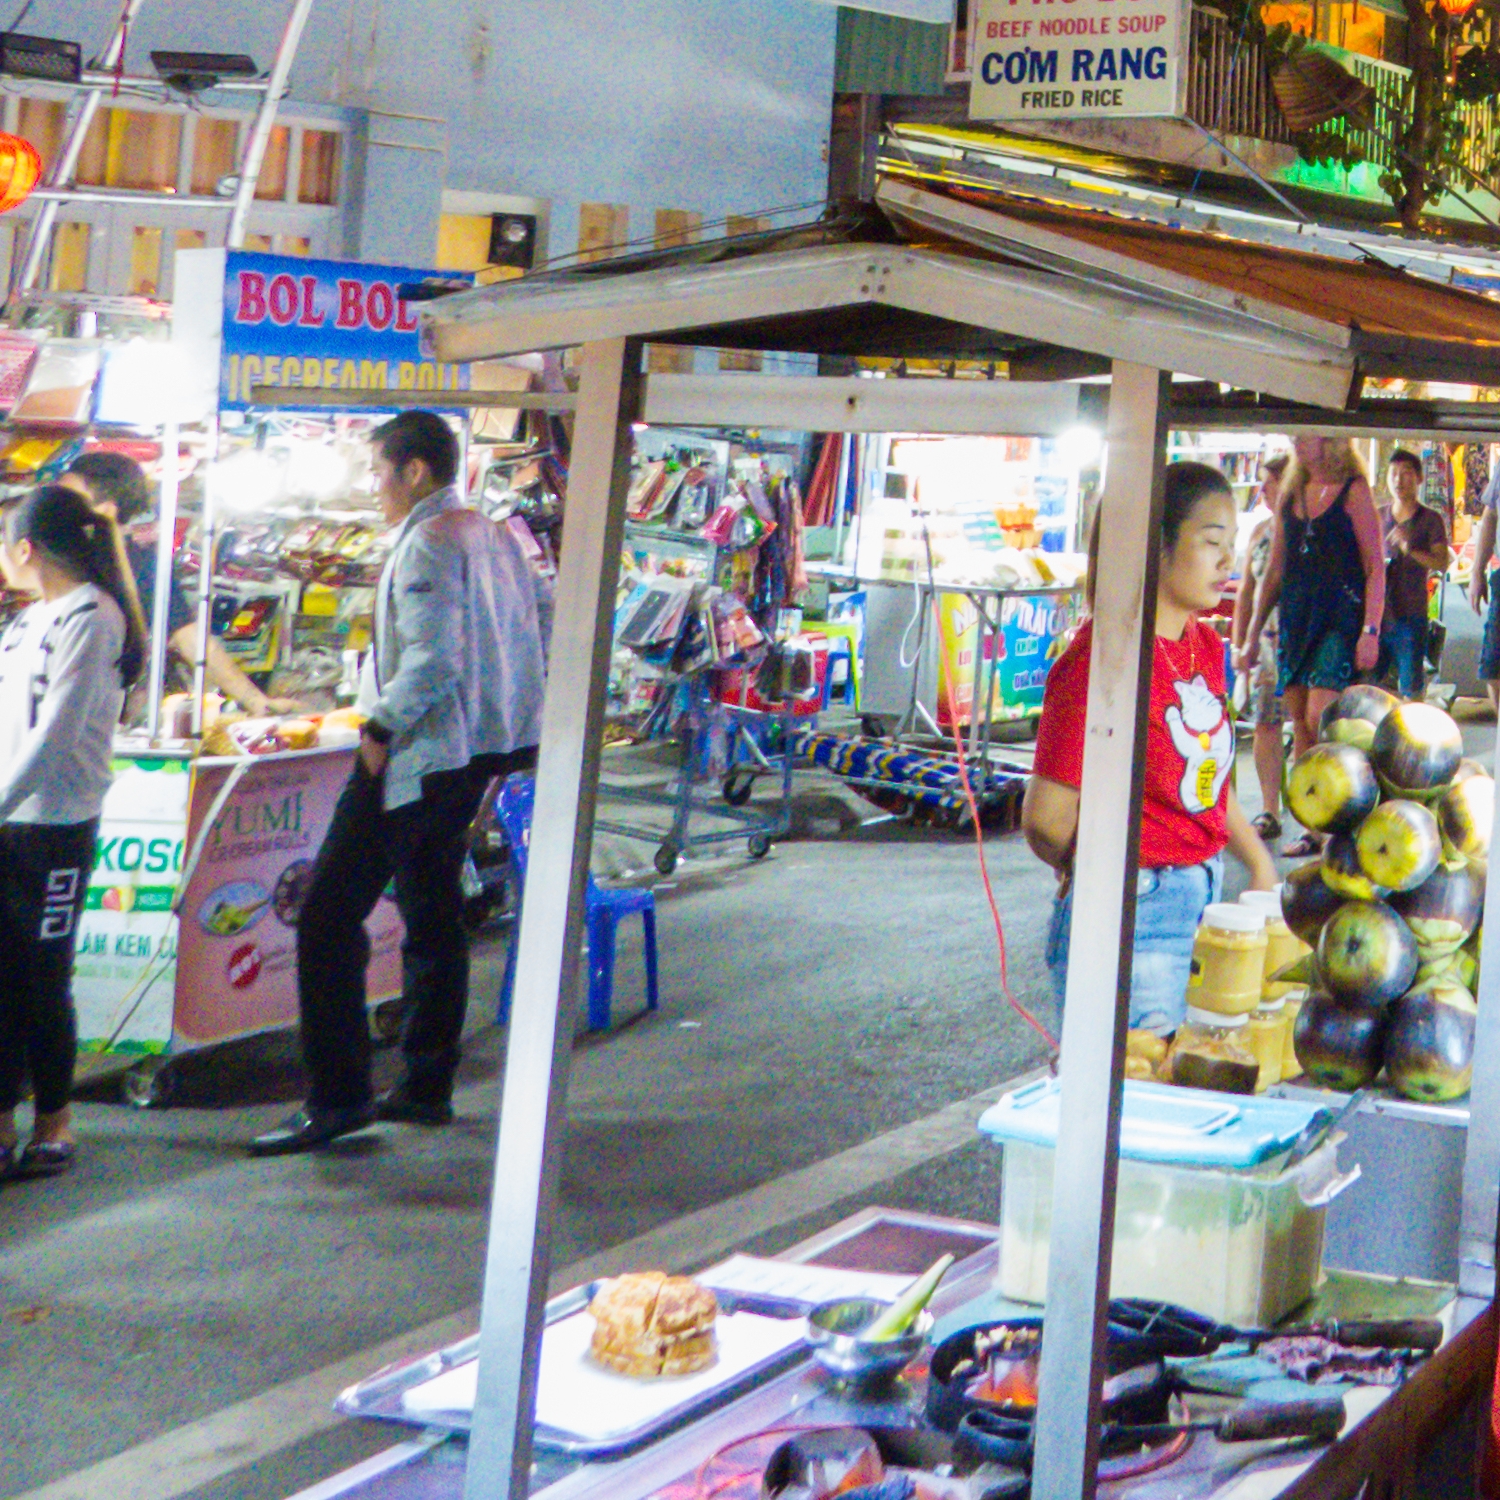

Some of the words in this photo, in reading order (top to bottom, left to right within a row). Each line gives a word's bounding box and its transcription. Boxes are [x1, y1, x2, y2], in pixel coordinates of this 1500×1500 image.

[986, 20, 1033, 39] BEEF
[1039, 17, 1111, 37] NOODLE
[1118, 14, 1167, 34] SOUP
[981, 45, 1059, 86] CƠM
[1071, 46, 1168, 82] RANG
[1020, 89, 1074, 109] FRIED
[1081, 88, 1123, 107] RICE
[235, 271, 325, 328] BOL
[335, 279, 418, 332] BOL
